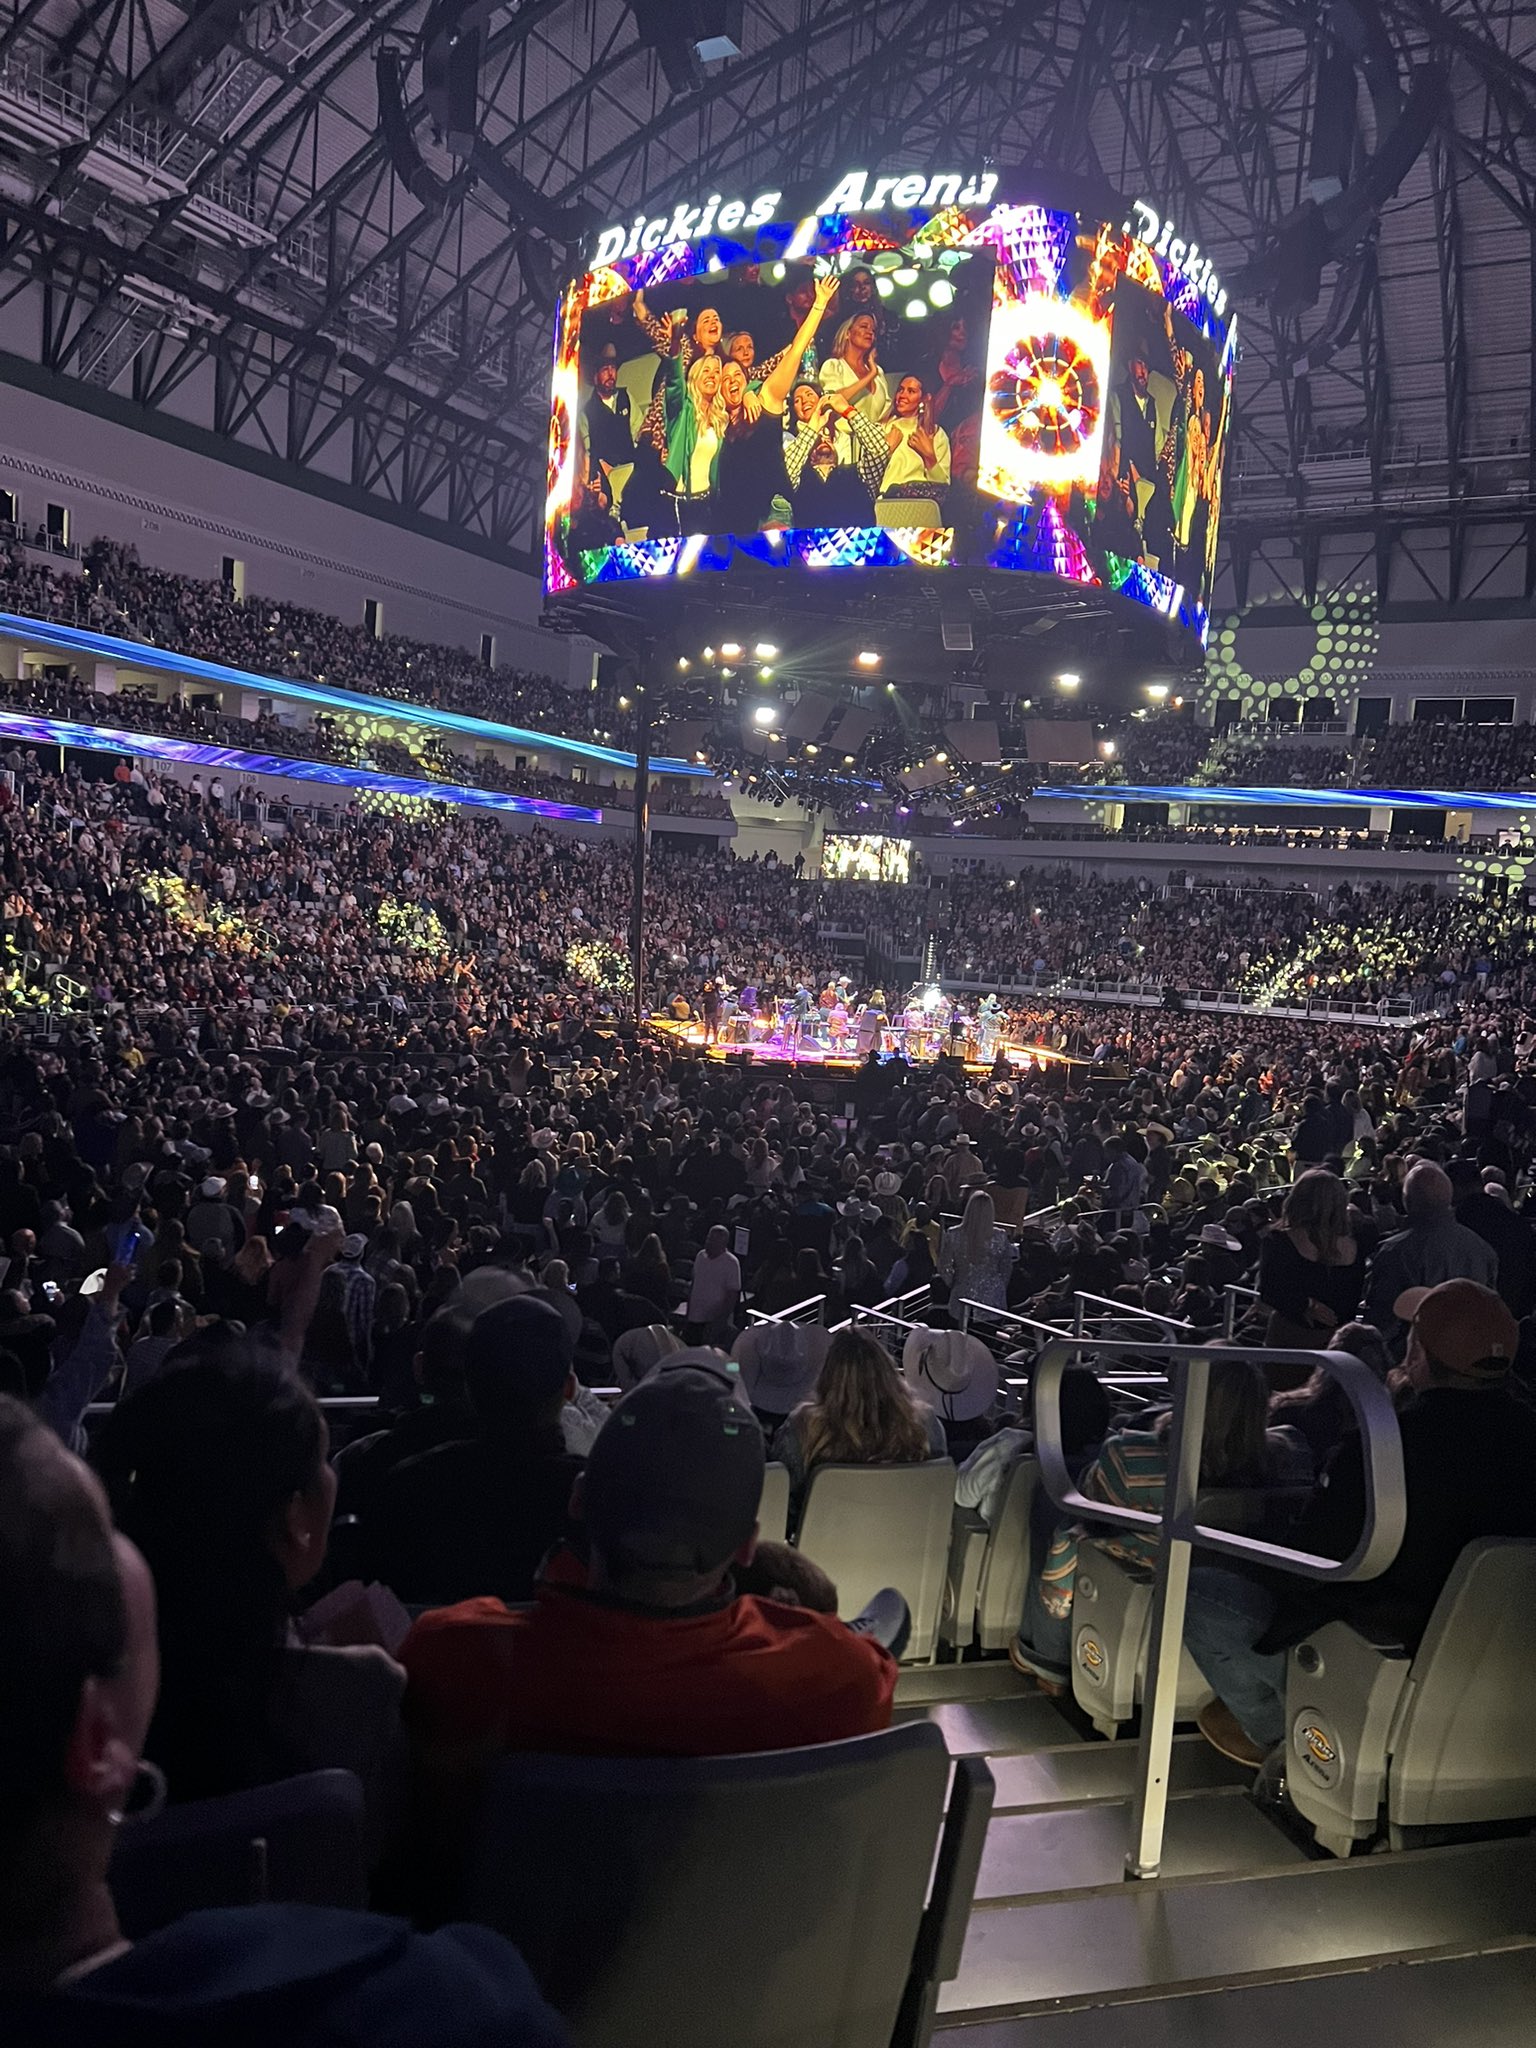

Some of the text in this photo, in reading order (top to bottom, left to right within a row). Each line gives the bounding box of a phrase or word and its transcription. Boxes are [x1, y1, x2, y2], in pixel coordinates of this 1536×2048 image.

[589, 171, 999, 271] Dickies Arena
[1121, 199, 1228, 317] Dickies
[154, 760, 173, 772] 107
[242, 772, 257, 784] 108
